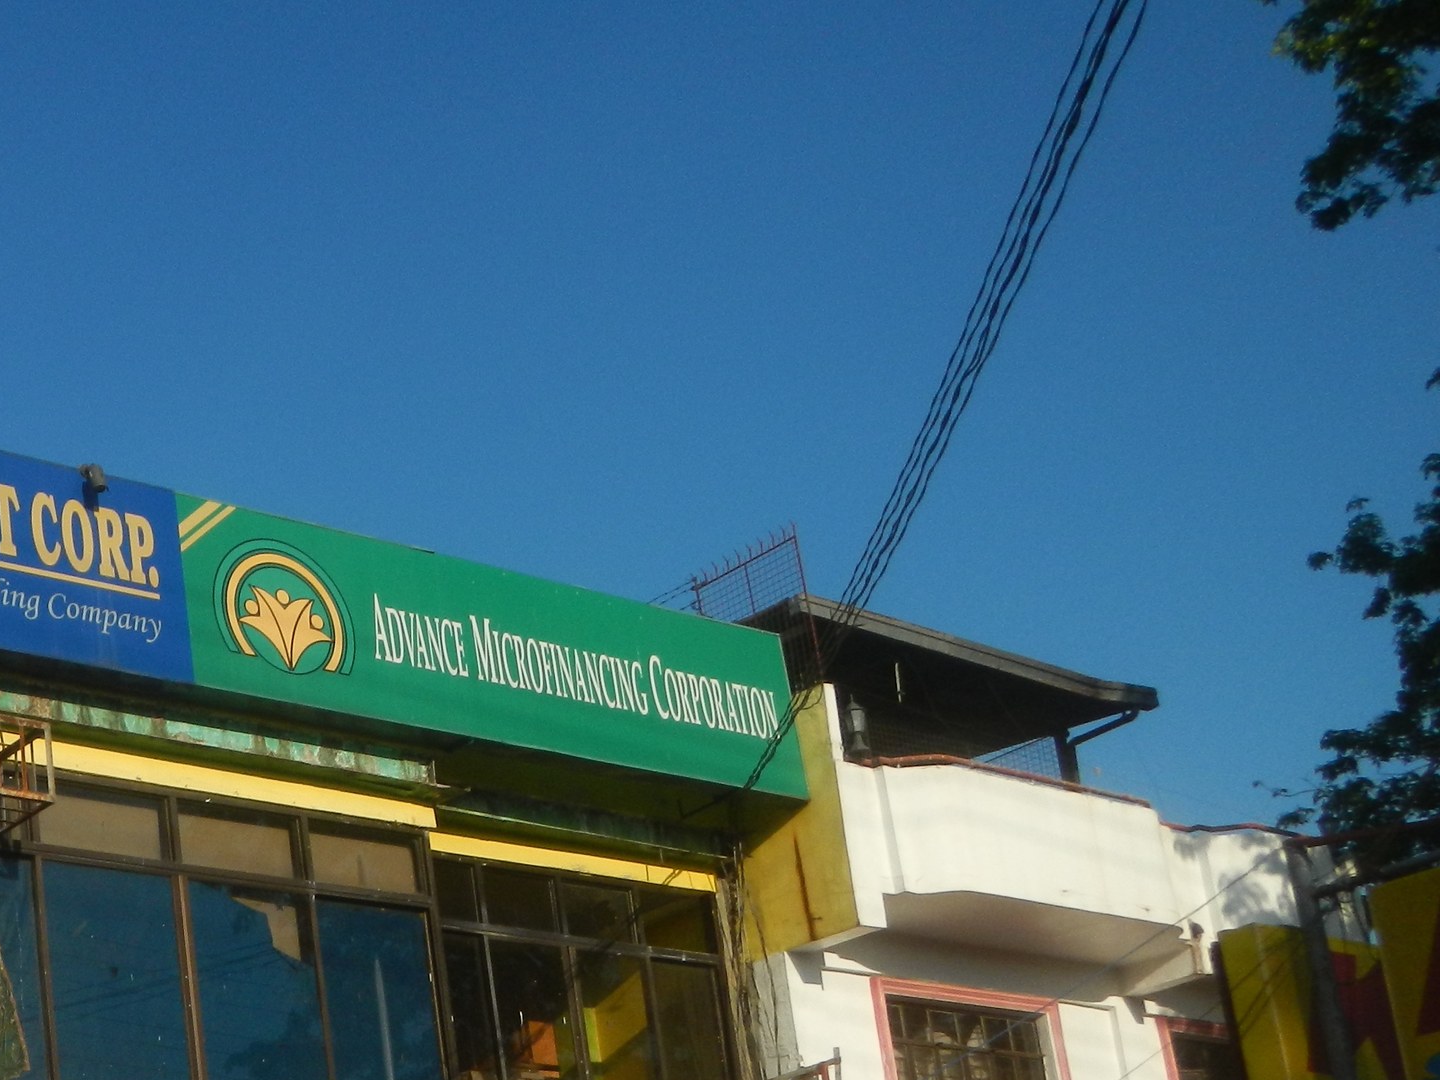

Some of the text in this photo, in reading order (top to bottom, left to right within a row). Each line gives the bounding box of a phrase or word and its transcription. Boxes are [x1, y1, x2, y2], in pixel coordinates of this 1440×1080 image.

[30, 492, 162, 588] CORP.
[48, 592, 162, 642] Company
[373, 592, 782, 742] ADVANCE MICROFINANCING CORPORATION
